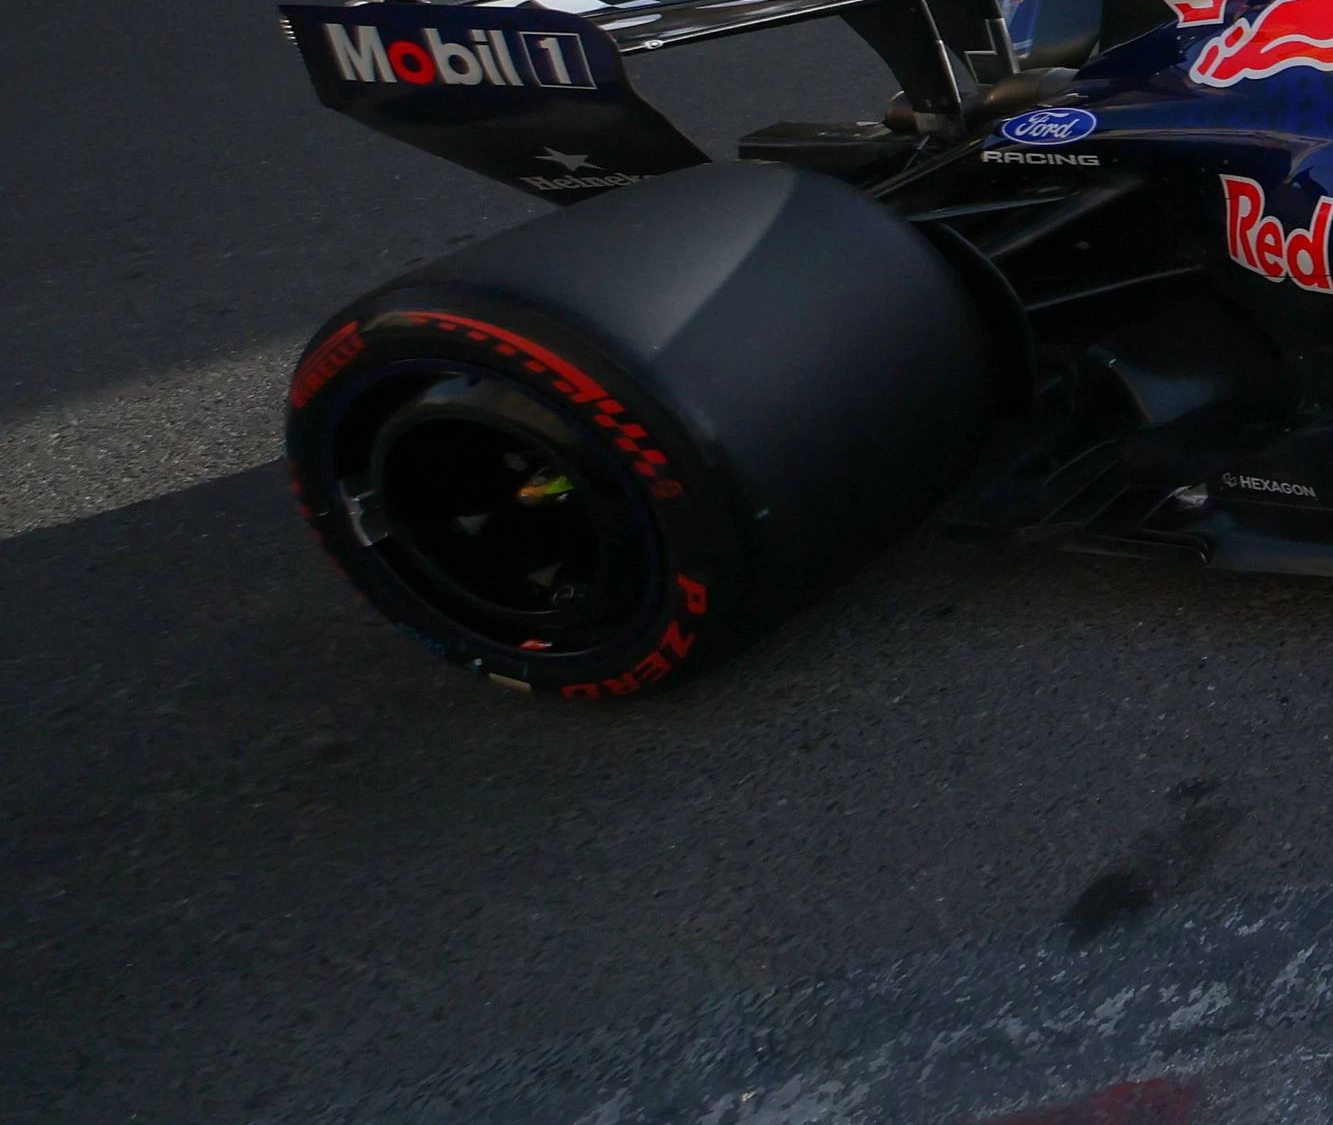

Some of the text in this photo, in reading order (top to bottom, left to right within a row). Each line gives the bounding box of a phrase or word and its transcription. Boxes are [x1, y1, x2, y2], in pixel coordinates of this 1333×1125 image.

[324, 23, 525, 87] Mobil
[1015, 110, 1075, 139] Ford
[983, 150, 1100, 166] RACING
[1238, 475, 1317, 499] HEXAGON
[562, 574, 708, 701] P ZERO
